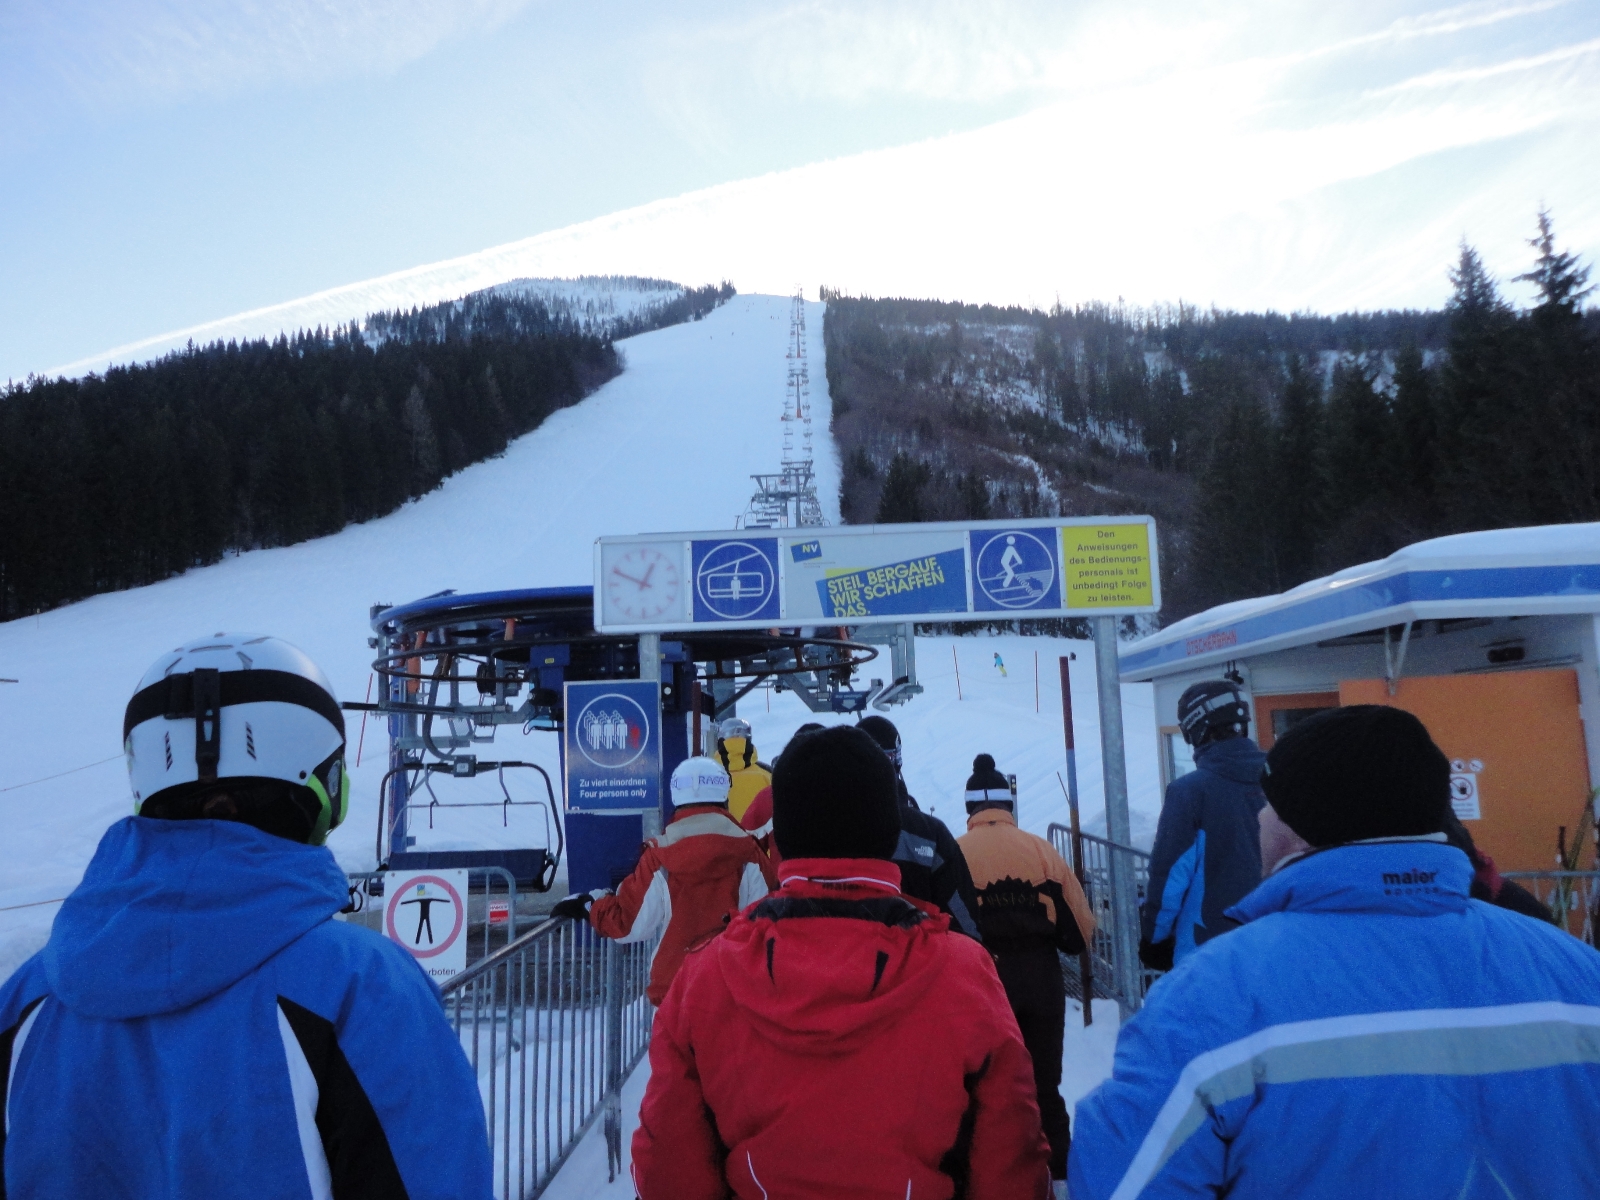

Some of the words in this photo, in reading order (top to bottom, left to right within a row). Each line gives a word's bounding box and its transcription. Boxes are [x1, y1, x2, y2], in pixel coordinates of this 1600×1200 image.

[1097, 530, 1115, 538] Den
[802, 544, 818, 553] NV
[1077, 543, 1138, 552] Anweisungen
[1069, 557, 1085, 565] des
[1088, 555, 1147, 564] Bedienungs-
[1079, 568, 1124, 578] personals
[1127, 567, 1138, 575] ist
[827, 574, 865, 594] STEIL
[830, 588, 861, 607] WIR
[863, 569, 945, 600] SCHAFFEN
[1072, 581, 1118, 590] unbedingt
[1121, 580, 1147, 589] Folge
[1101, 594, 1134, 602] leisten.
[833, 601, 871, 618] DAS.
[579, 778, 590, 788] Zu
[591, 778, 608, 787] viert
[609, 777, 647, 786] einordnen
[579, 789, 597, 798] Four
[599, 789, 629, 799] persons
[630, 788, 647, 798] only
[1382, 867, 1437, 885] maier
[427, 967, 456, 976] rboten
